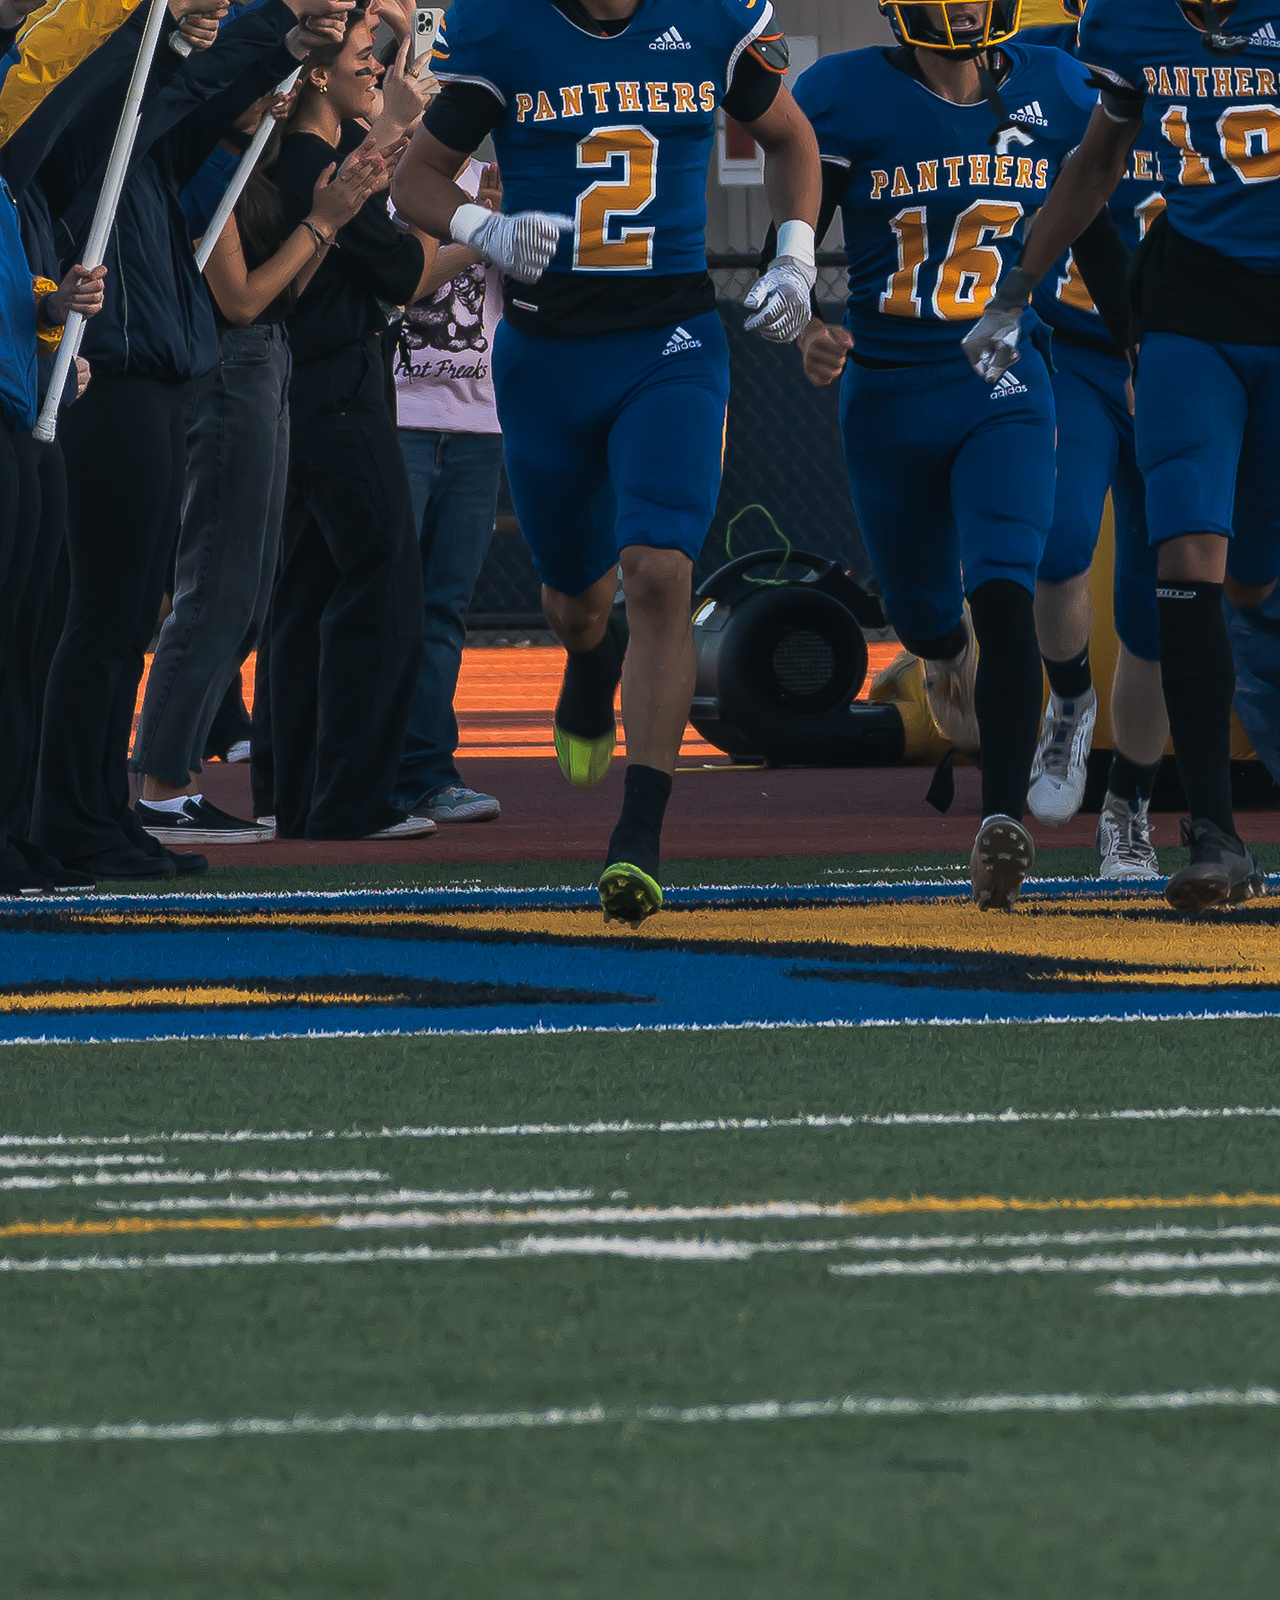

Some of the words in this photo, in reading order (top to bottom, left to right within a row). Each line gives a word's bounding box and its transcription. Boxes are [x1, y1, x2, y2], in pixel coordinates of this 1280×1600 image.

[649, 39, 692, 50] adidas
[515, 81, 715, 122] PANTHERS
[1009, 112, 1049, 127] adidas
[870, 154, 1049, 200] PANTHERS
[572, 124, 659, 271] 2
[878, 199, 1025, 322] 16
[662, 338, 703, 356] adidas
[434, 357, 489, 380] Freaks
[990, 384, 1029, 400] adidas
